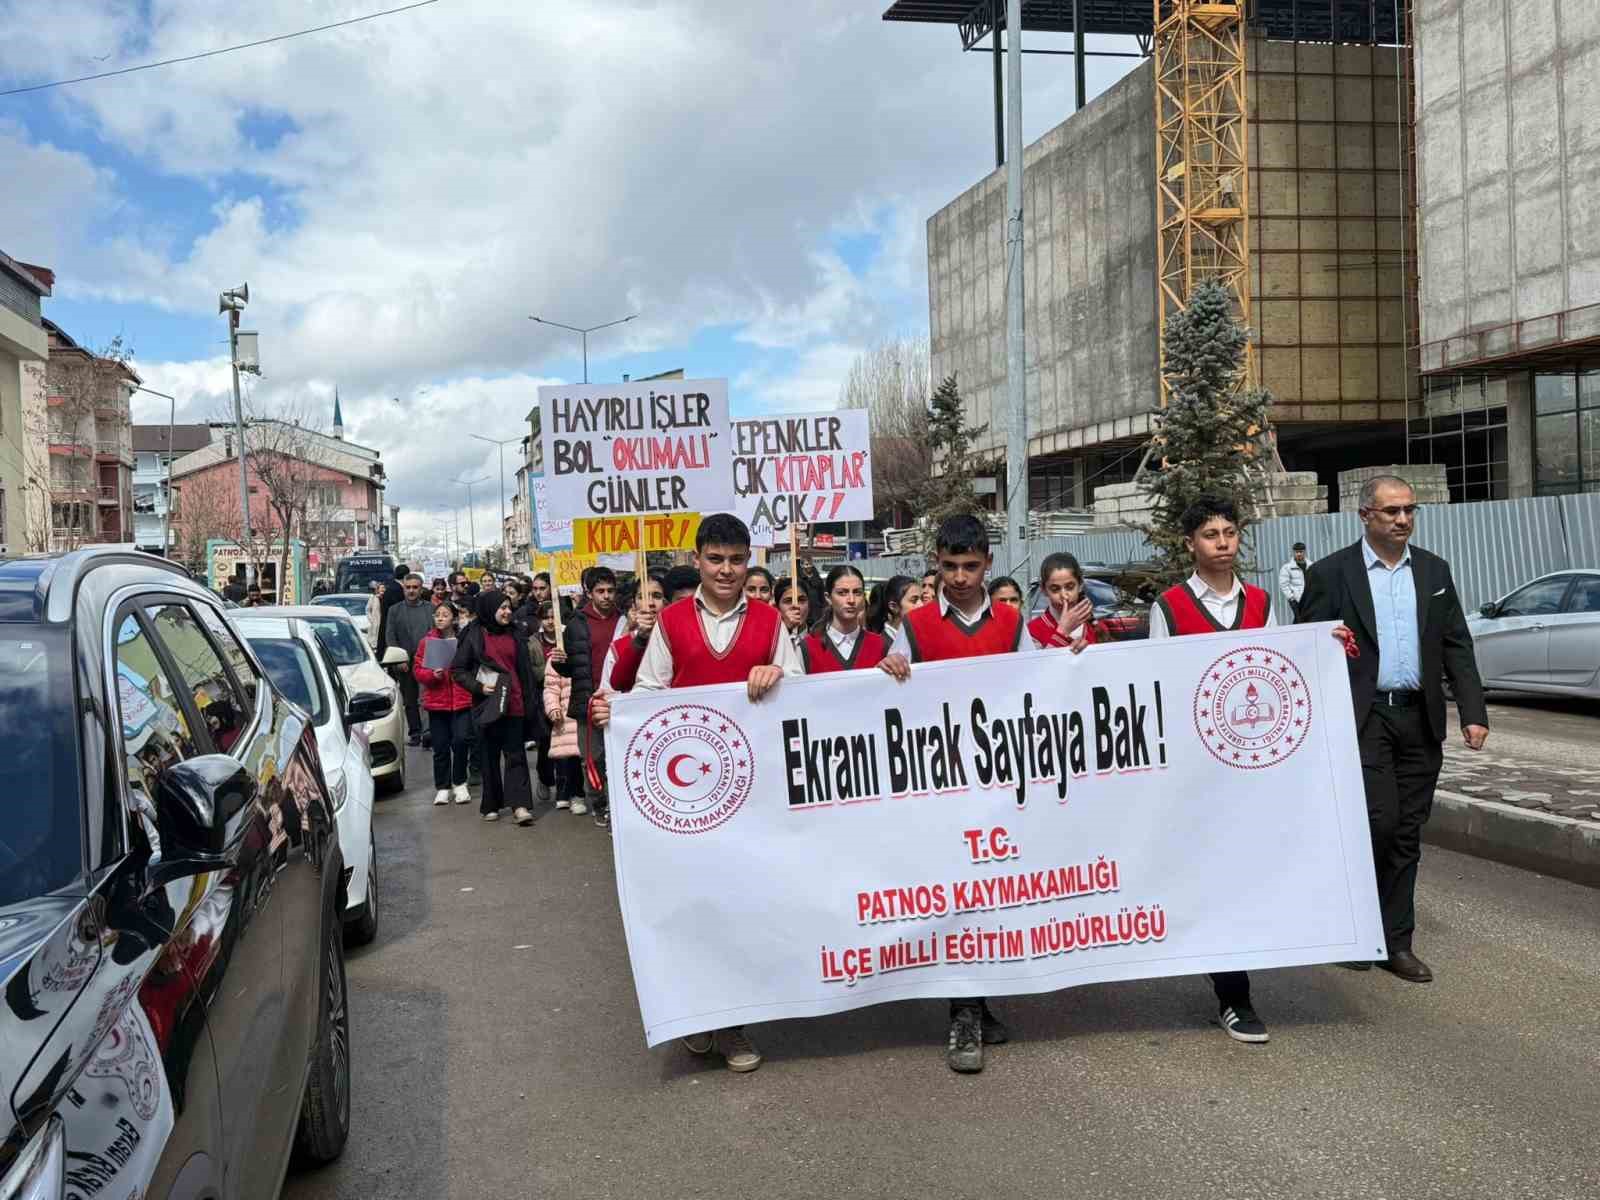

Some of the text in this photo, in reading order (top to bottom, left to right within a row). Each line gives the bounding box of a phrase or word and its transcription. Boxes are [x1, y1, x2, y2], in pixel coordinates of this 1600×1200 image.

[552, 391, 711, 433] HAYIRLI İŞLER
[553, 438, 604, 475] BOL
[730, 416, 843, 456] EPENKLER
[587, 474, 688, 514] GÜNLER
[732, 455, 768, 498] ÇIK
[647, 729, 692, 773] CUMHURİYETİ
[782, 717, 880, 806] Ekranı
[884, 701, 968, 796] Bırak
[970, 692, 1087, 806] Sayfaya
[649, 776, 677, 808] TÜRKİYE
[708, 755, 730, 803] BAKANLIĞI
[634, 775, 748, 829] PATNOS KAYMAKAMLIĞI
[964, 826, 1019, 861] T.C.
[857, 854, 1119, 922] PATNOS KAYMAKAMLIĞI
[820, 903, 1167, 984] İLÇE MİLLİ EĞİTİM MÜDÜRLÜĞÜ
